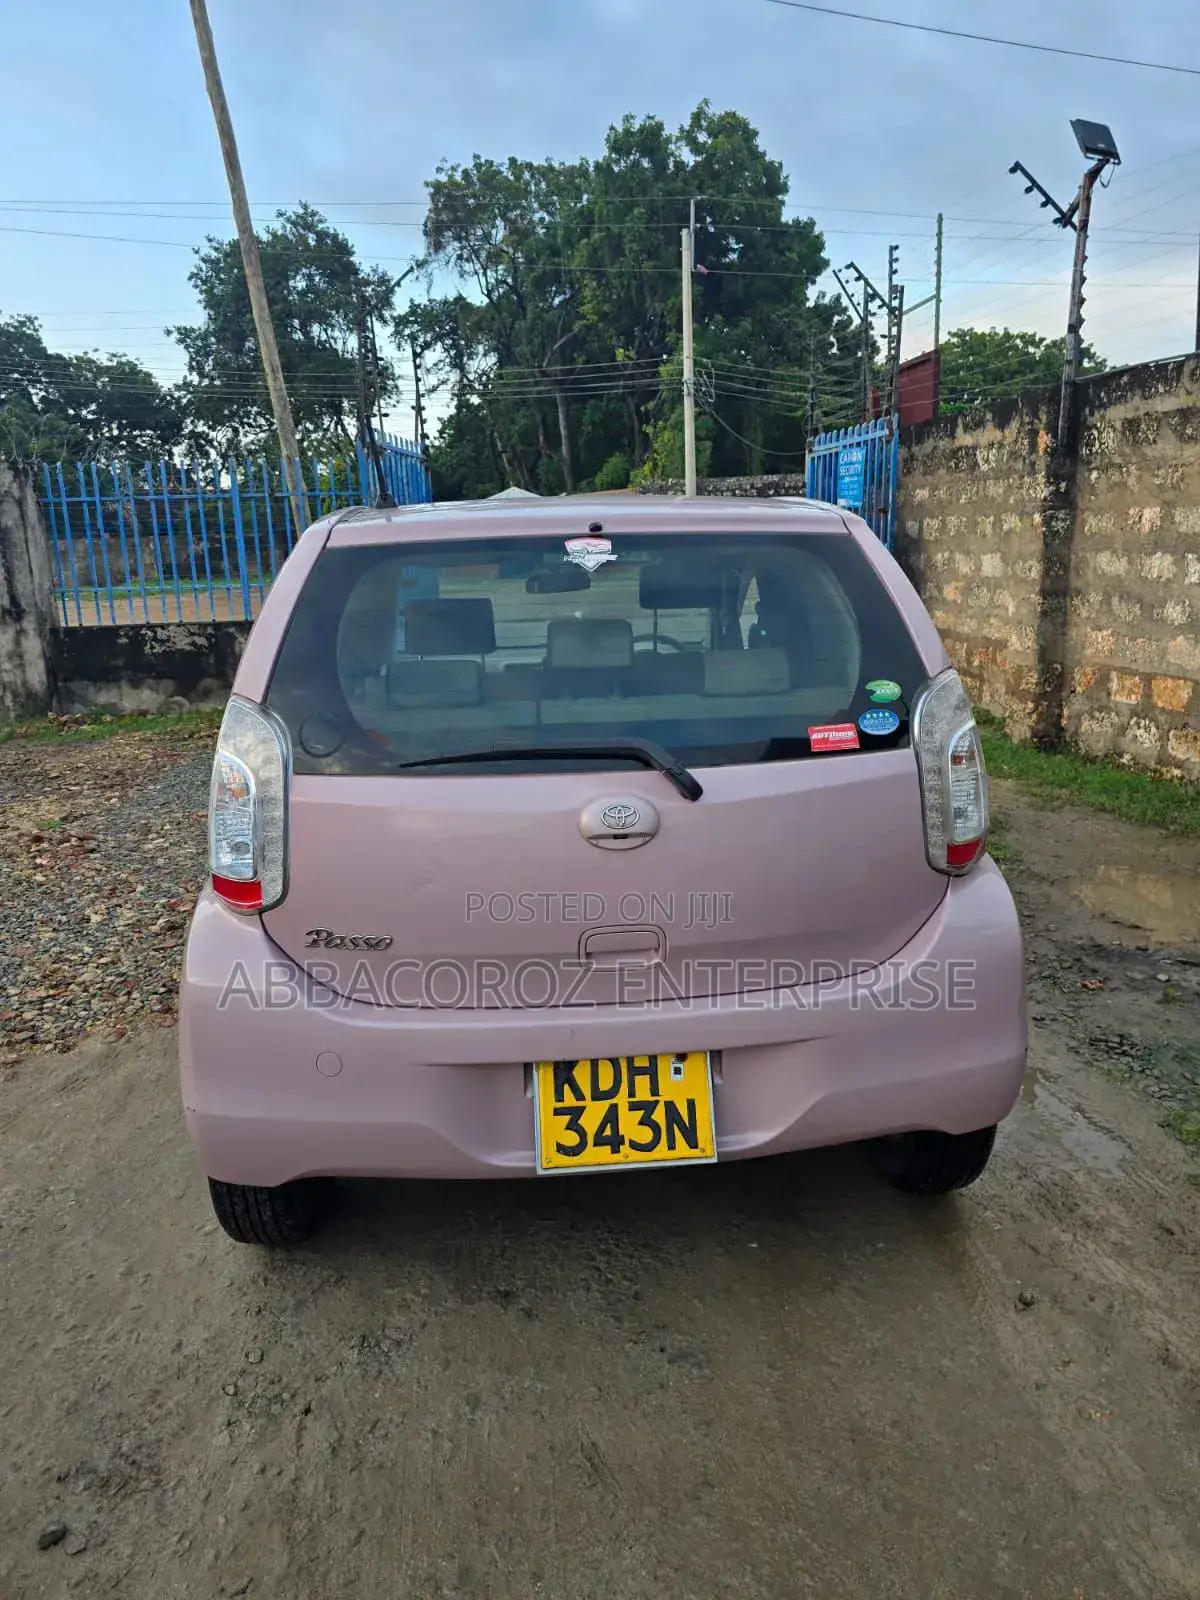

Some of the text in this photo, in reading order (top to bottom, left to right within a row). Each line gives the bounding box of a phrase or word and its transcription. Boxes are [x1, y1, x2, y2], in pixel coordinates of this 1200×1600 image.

[304, 926, 393, 951] Passo
[552, 1055, 661, 1103] KDH
[552, 1098, 699, 1158] 343N
